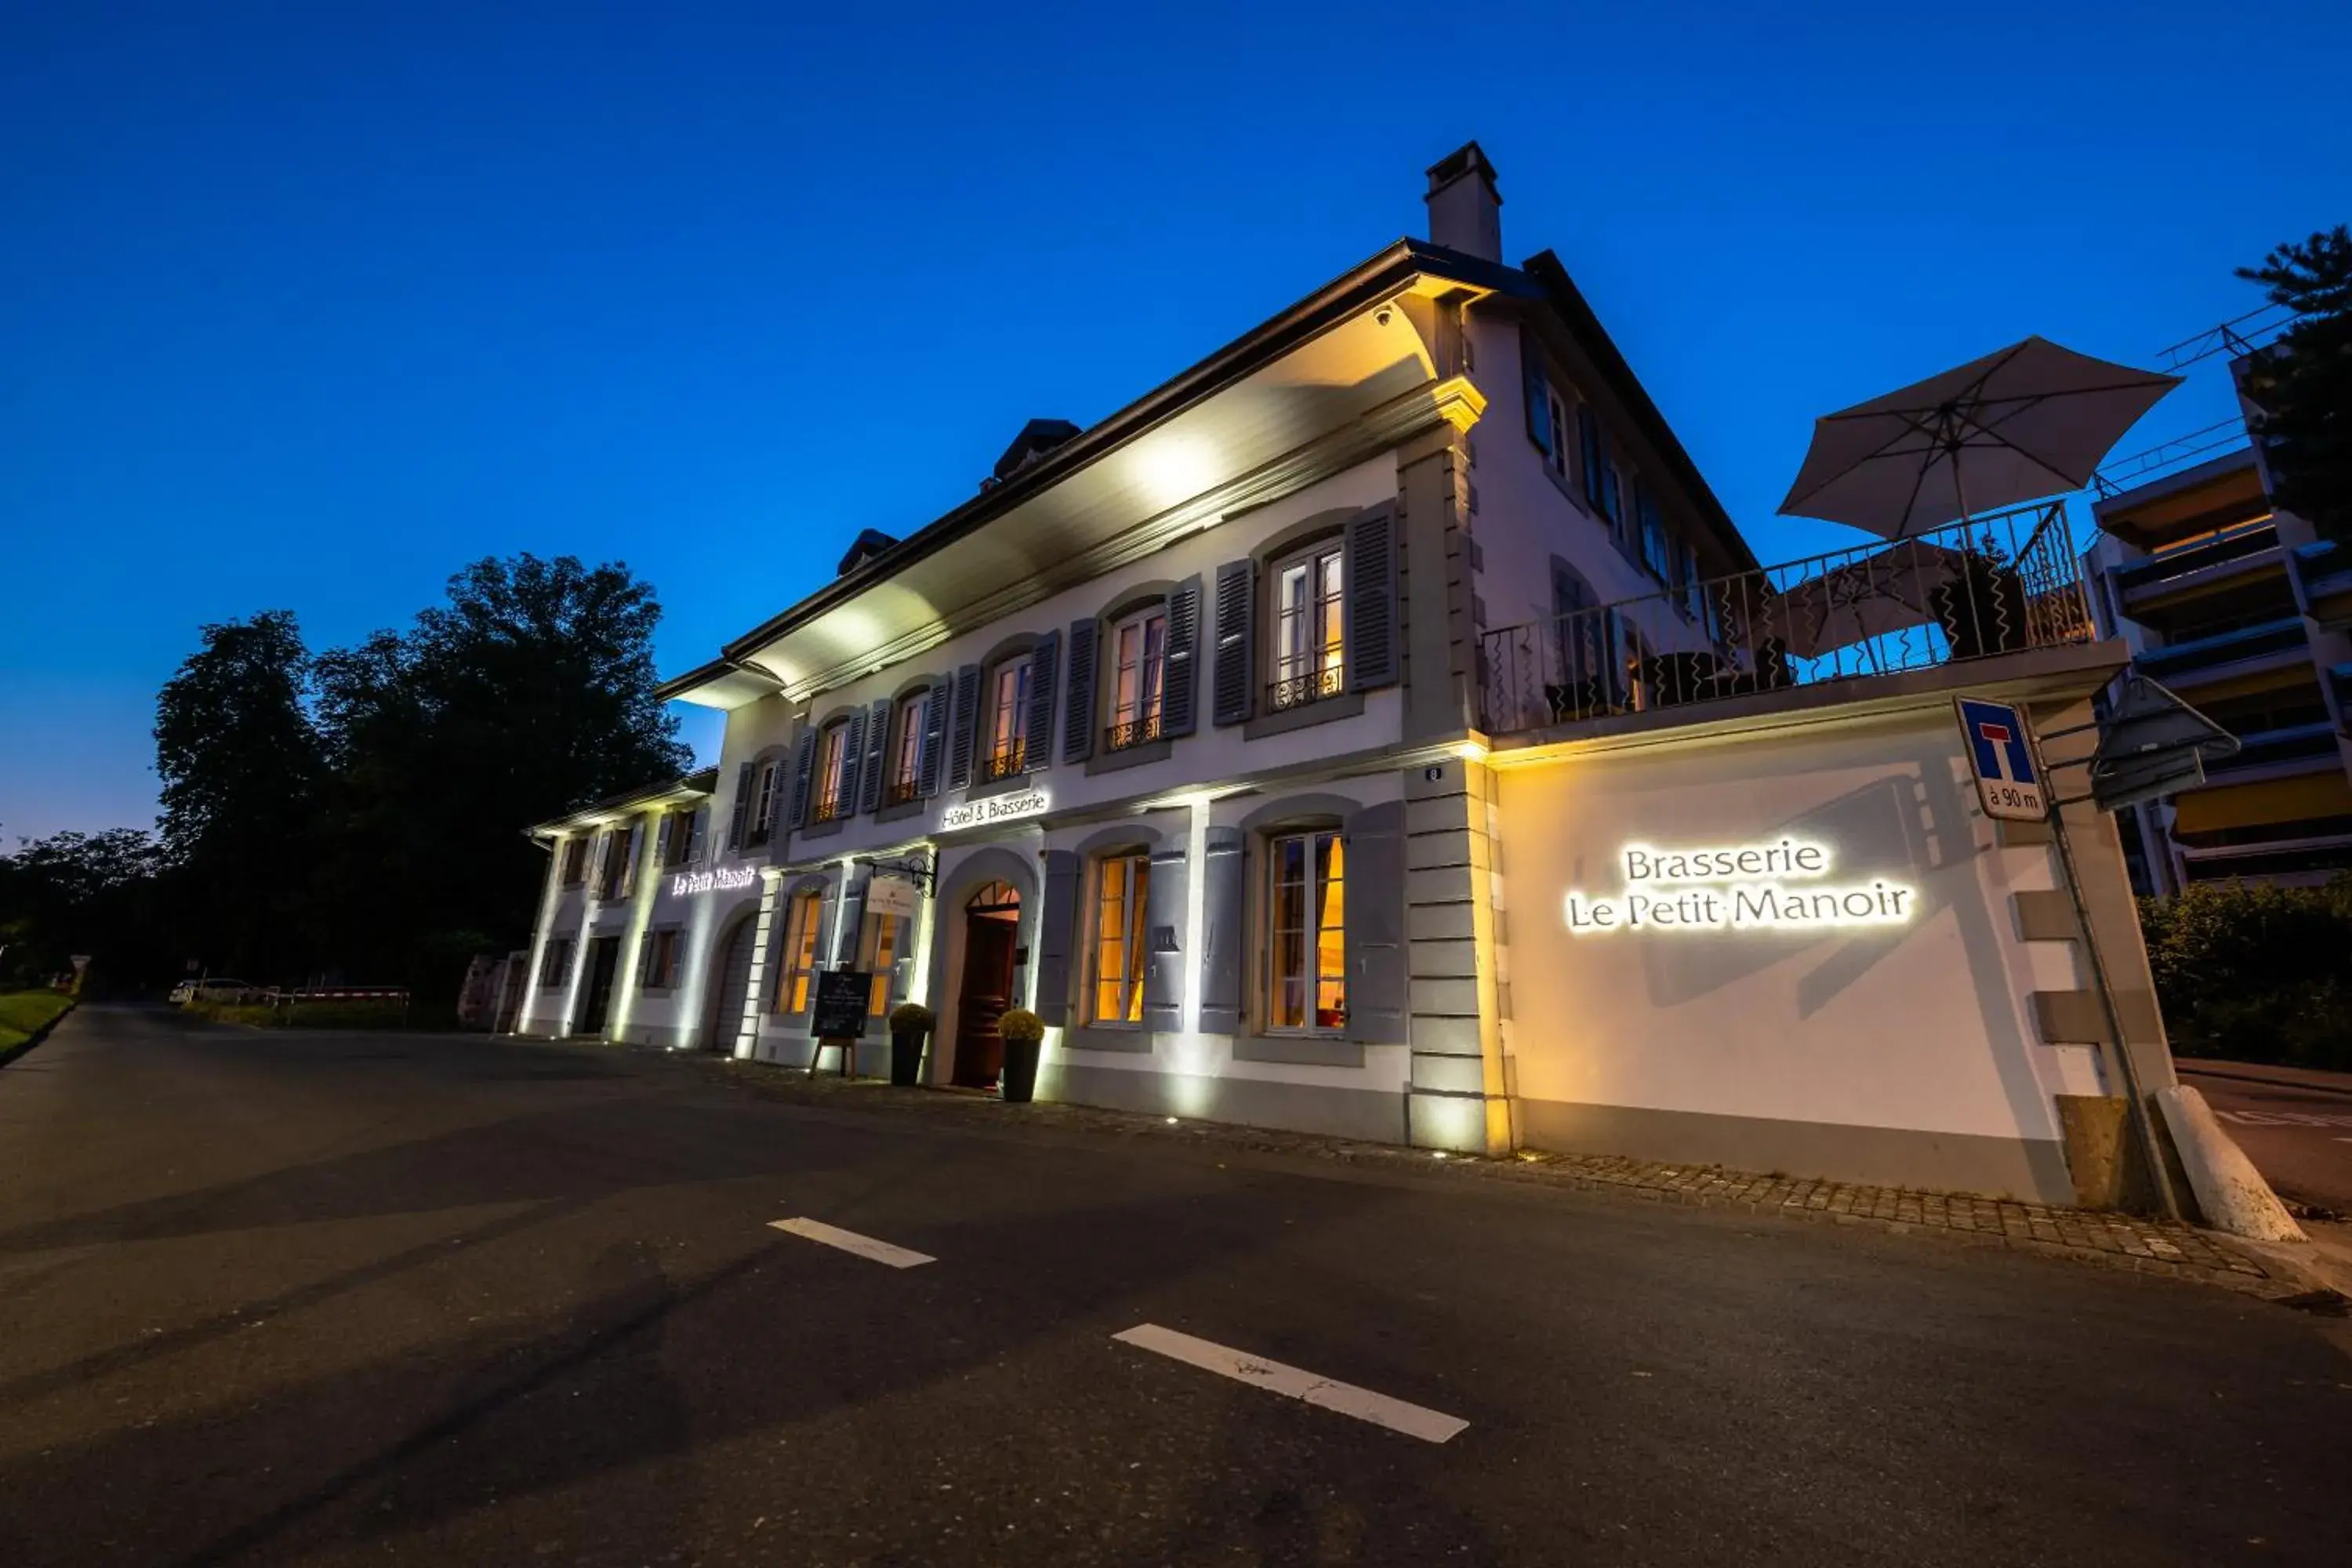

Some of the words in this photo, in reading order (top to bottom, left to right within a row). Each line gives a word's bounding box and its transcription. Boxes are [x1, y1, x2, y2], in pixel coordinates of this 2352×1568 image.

[942, 807, 973, 829] Hôtel
[976, 805, 985, 821] &
[989, 794, 1044, 818] Brasserie
[1991, 787, 2000, 805] à
[2002, 788, 2021, 807] 90
[2024, 793, 2038, 810] m
[1627, 840, 1823, 880] Brasserie
[1569, 897, 1614, 927] Le
[1628, 892, 1719, 924] Petit
[1734, 883, 1908, 922] Manoir
